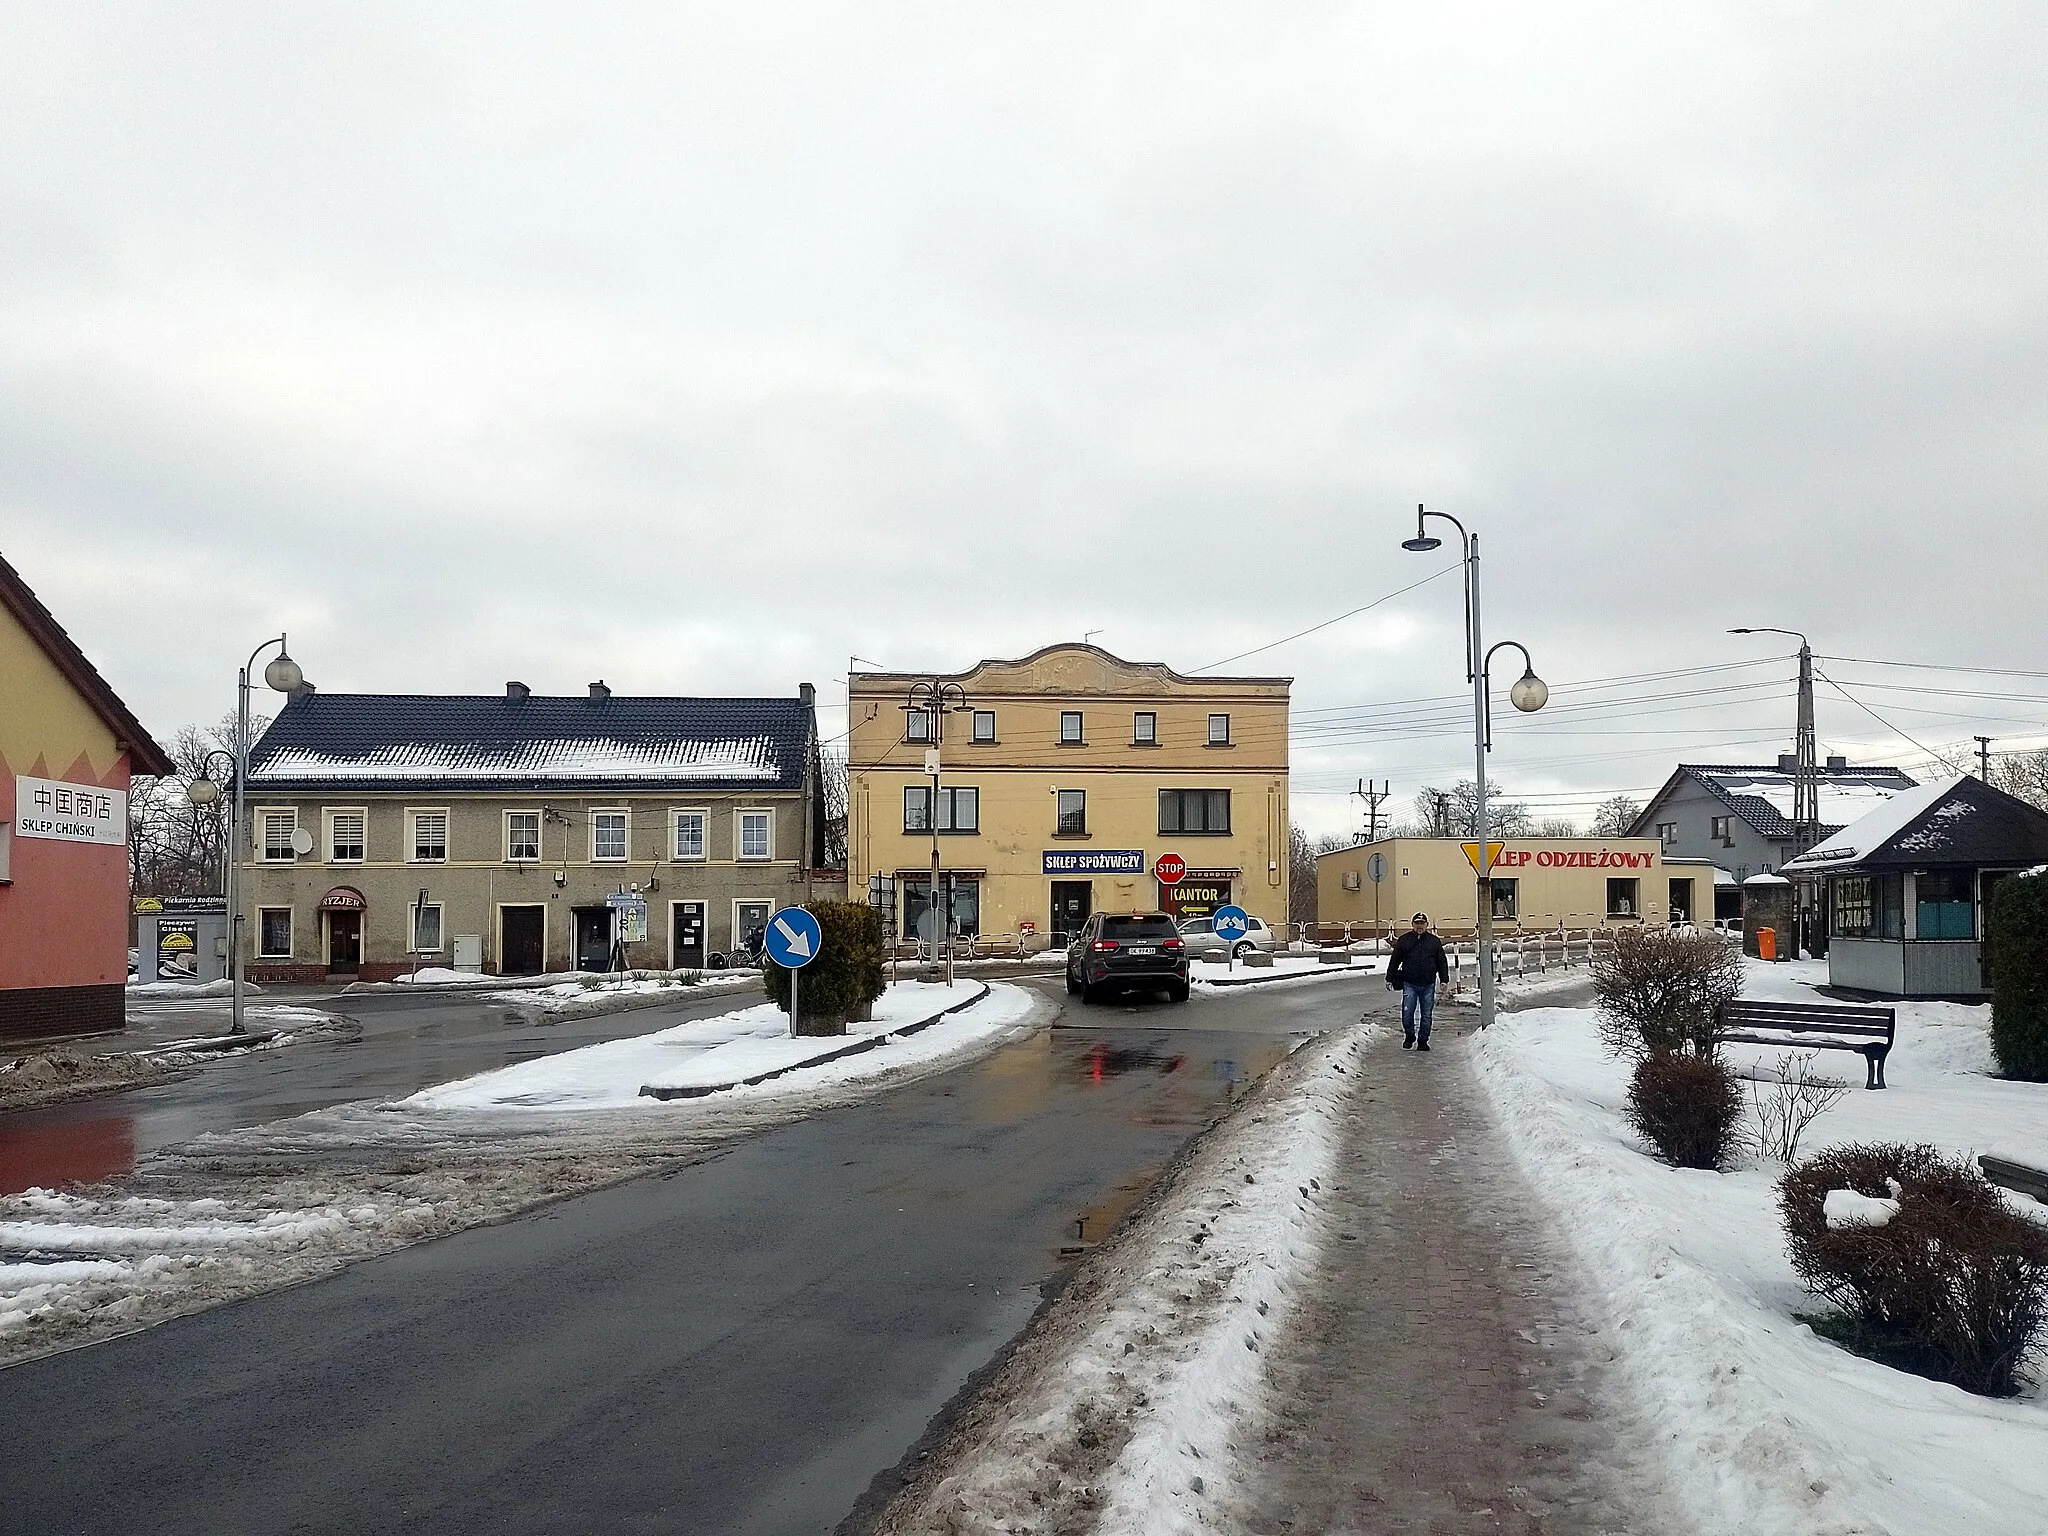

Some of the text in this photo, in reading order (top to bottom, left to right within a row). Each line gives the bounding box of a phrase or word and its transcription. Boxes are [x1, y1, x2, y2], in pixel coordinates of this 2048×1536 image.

[34, 784, 111, 820] 中国商店
[21, 818, 53, 833] SKLEP
[55, 821, 95, 838] CHIŃSKI
[1046, 853, 1140, 869] SKLEP SPOŻYWCZY
[1494, 847, 1655, 868] LEP ODZIEŻOWY
[1158, 863, 1184, 874] STOP
[164, 896, 196, 904] Piekarnia
[322, 896, 360, 907] RYZJER
[1170, 888, 1218, 901] KANTOR
